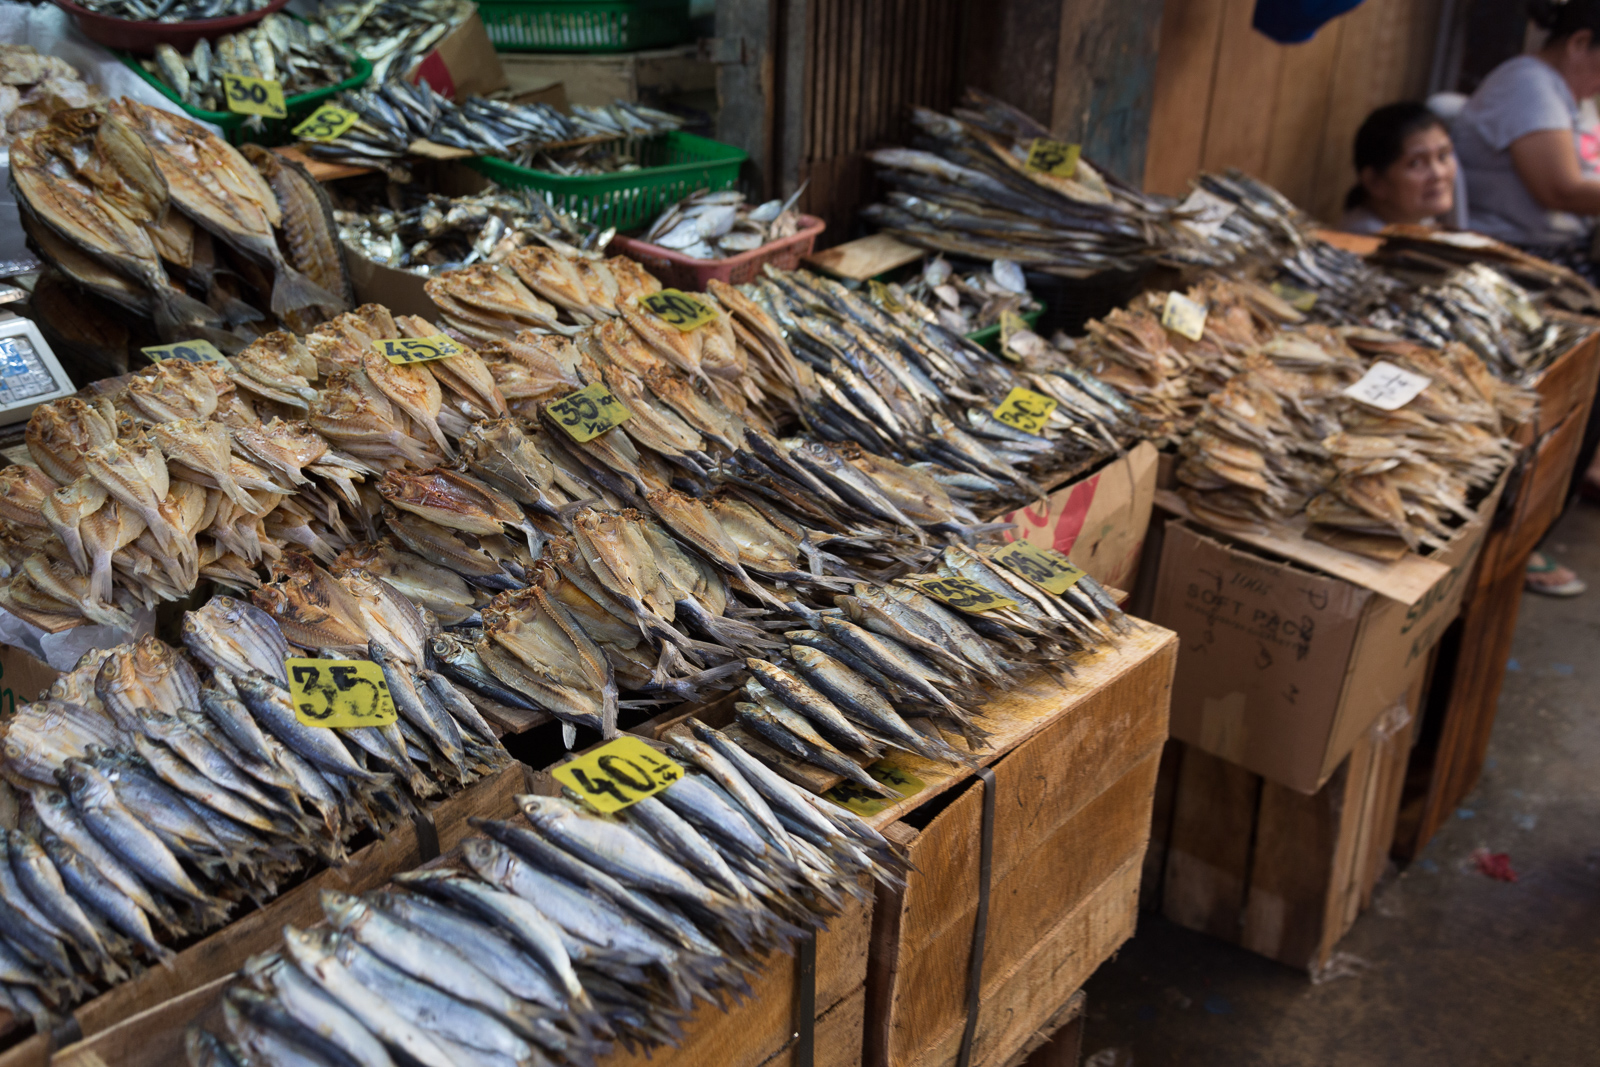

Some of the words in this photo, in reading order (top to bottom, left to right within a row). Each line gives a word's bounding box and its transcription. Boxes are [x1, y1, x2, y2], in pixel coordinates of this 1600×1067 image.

[227, 77, 268, 106] 30
[645, 295, 699, 324] 50
[384, 341, 445, 362] 45
[550, 393, 599, 427] 35
[922, 578, 995, 607] 35
[291, 665, 379, 720] 35
[569, 754, 657, 803] 40
